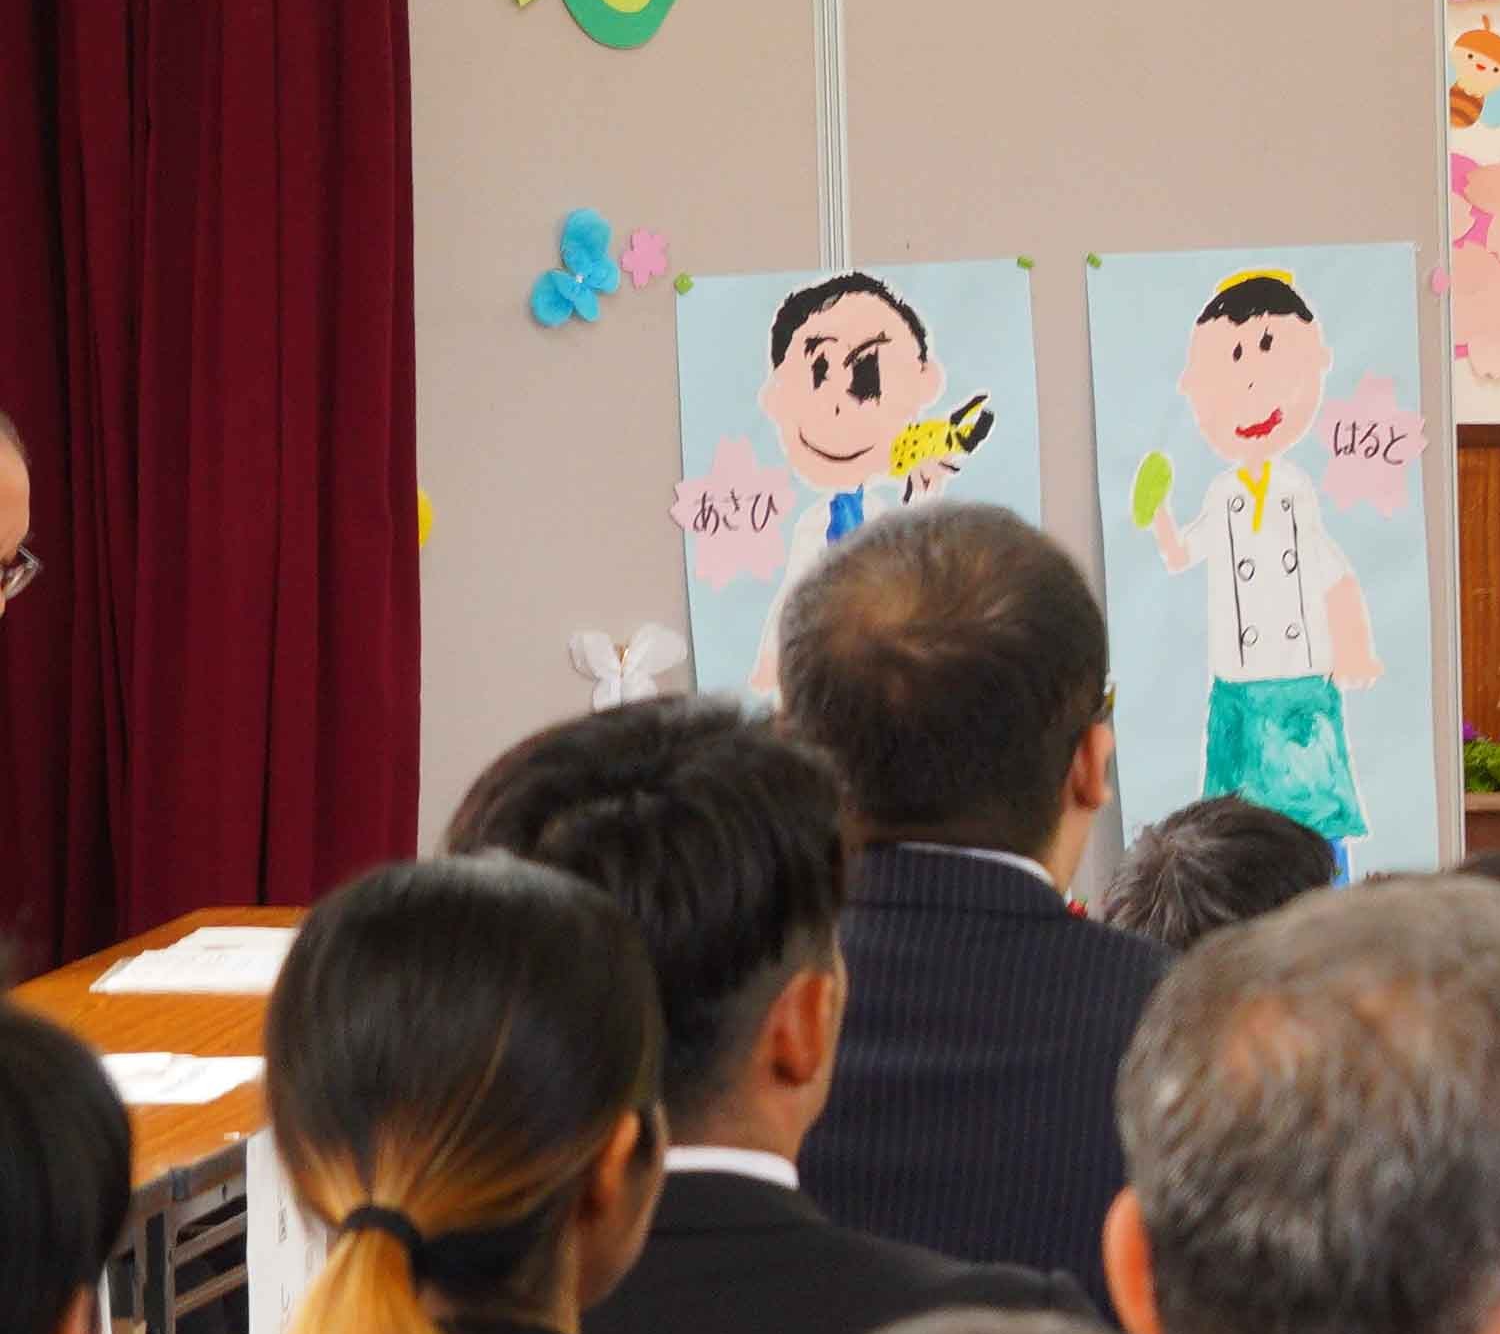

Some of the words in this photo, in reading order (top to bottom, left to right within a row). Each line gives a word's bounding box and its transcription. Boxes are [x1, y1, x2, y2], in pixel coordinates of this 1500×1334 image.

[1332, 419, 1408, 466] はると
[691, 487, 780, 537] あさひ
